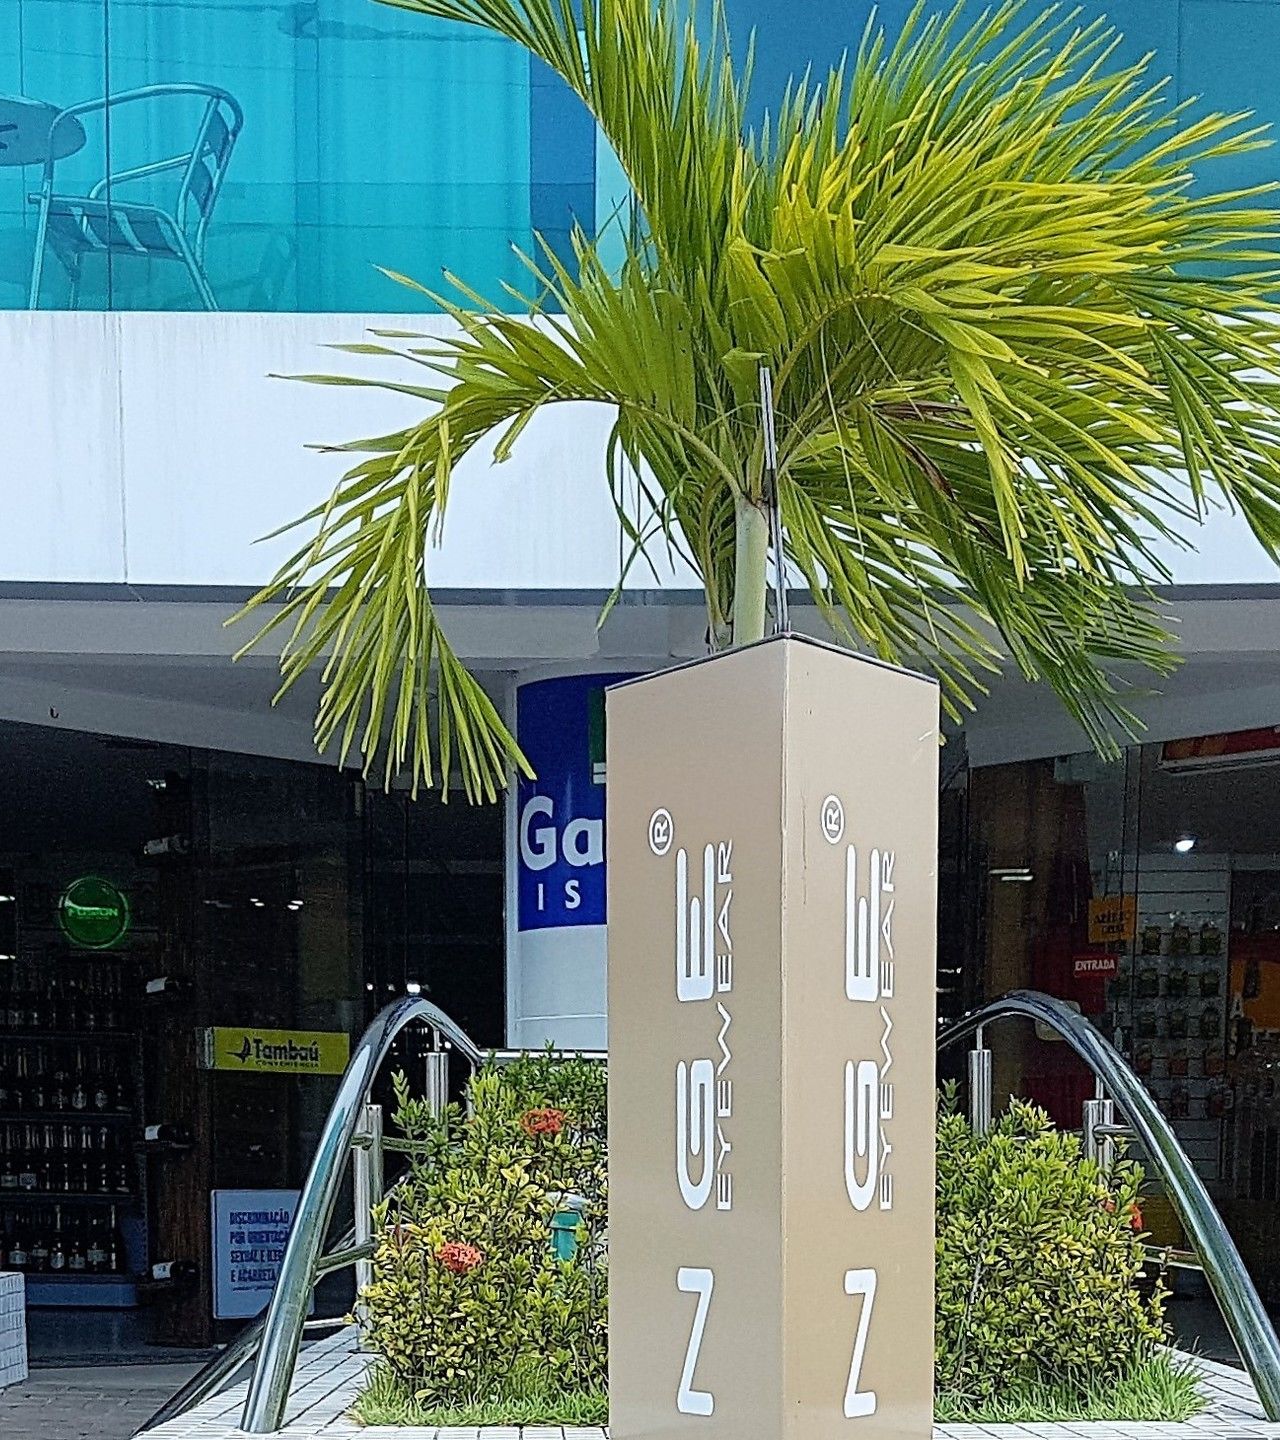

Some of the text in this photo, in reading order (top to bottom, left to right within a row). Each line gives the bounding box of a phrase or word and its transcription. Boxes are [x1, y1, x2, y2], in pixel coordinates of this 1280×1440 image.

[253, 1038, 320, 1062] Tambaú
[716, 838, 733, 1211] EYEWEAR
[879, 850, 895, 1211] EYEWEAR
[1074, 959, 1115, 971] ENTRADA
